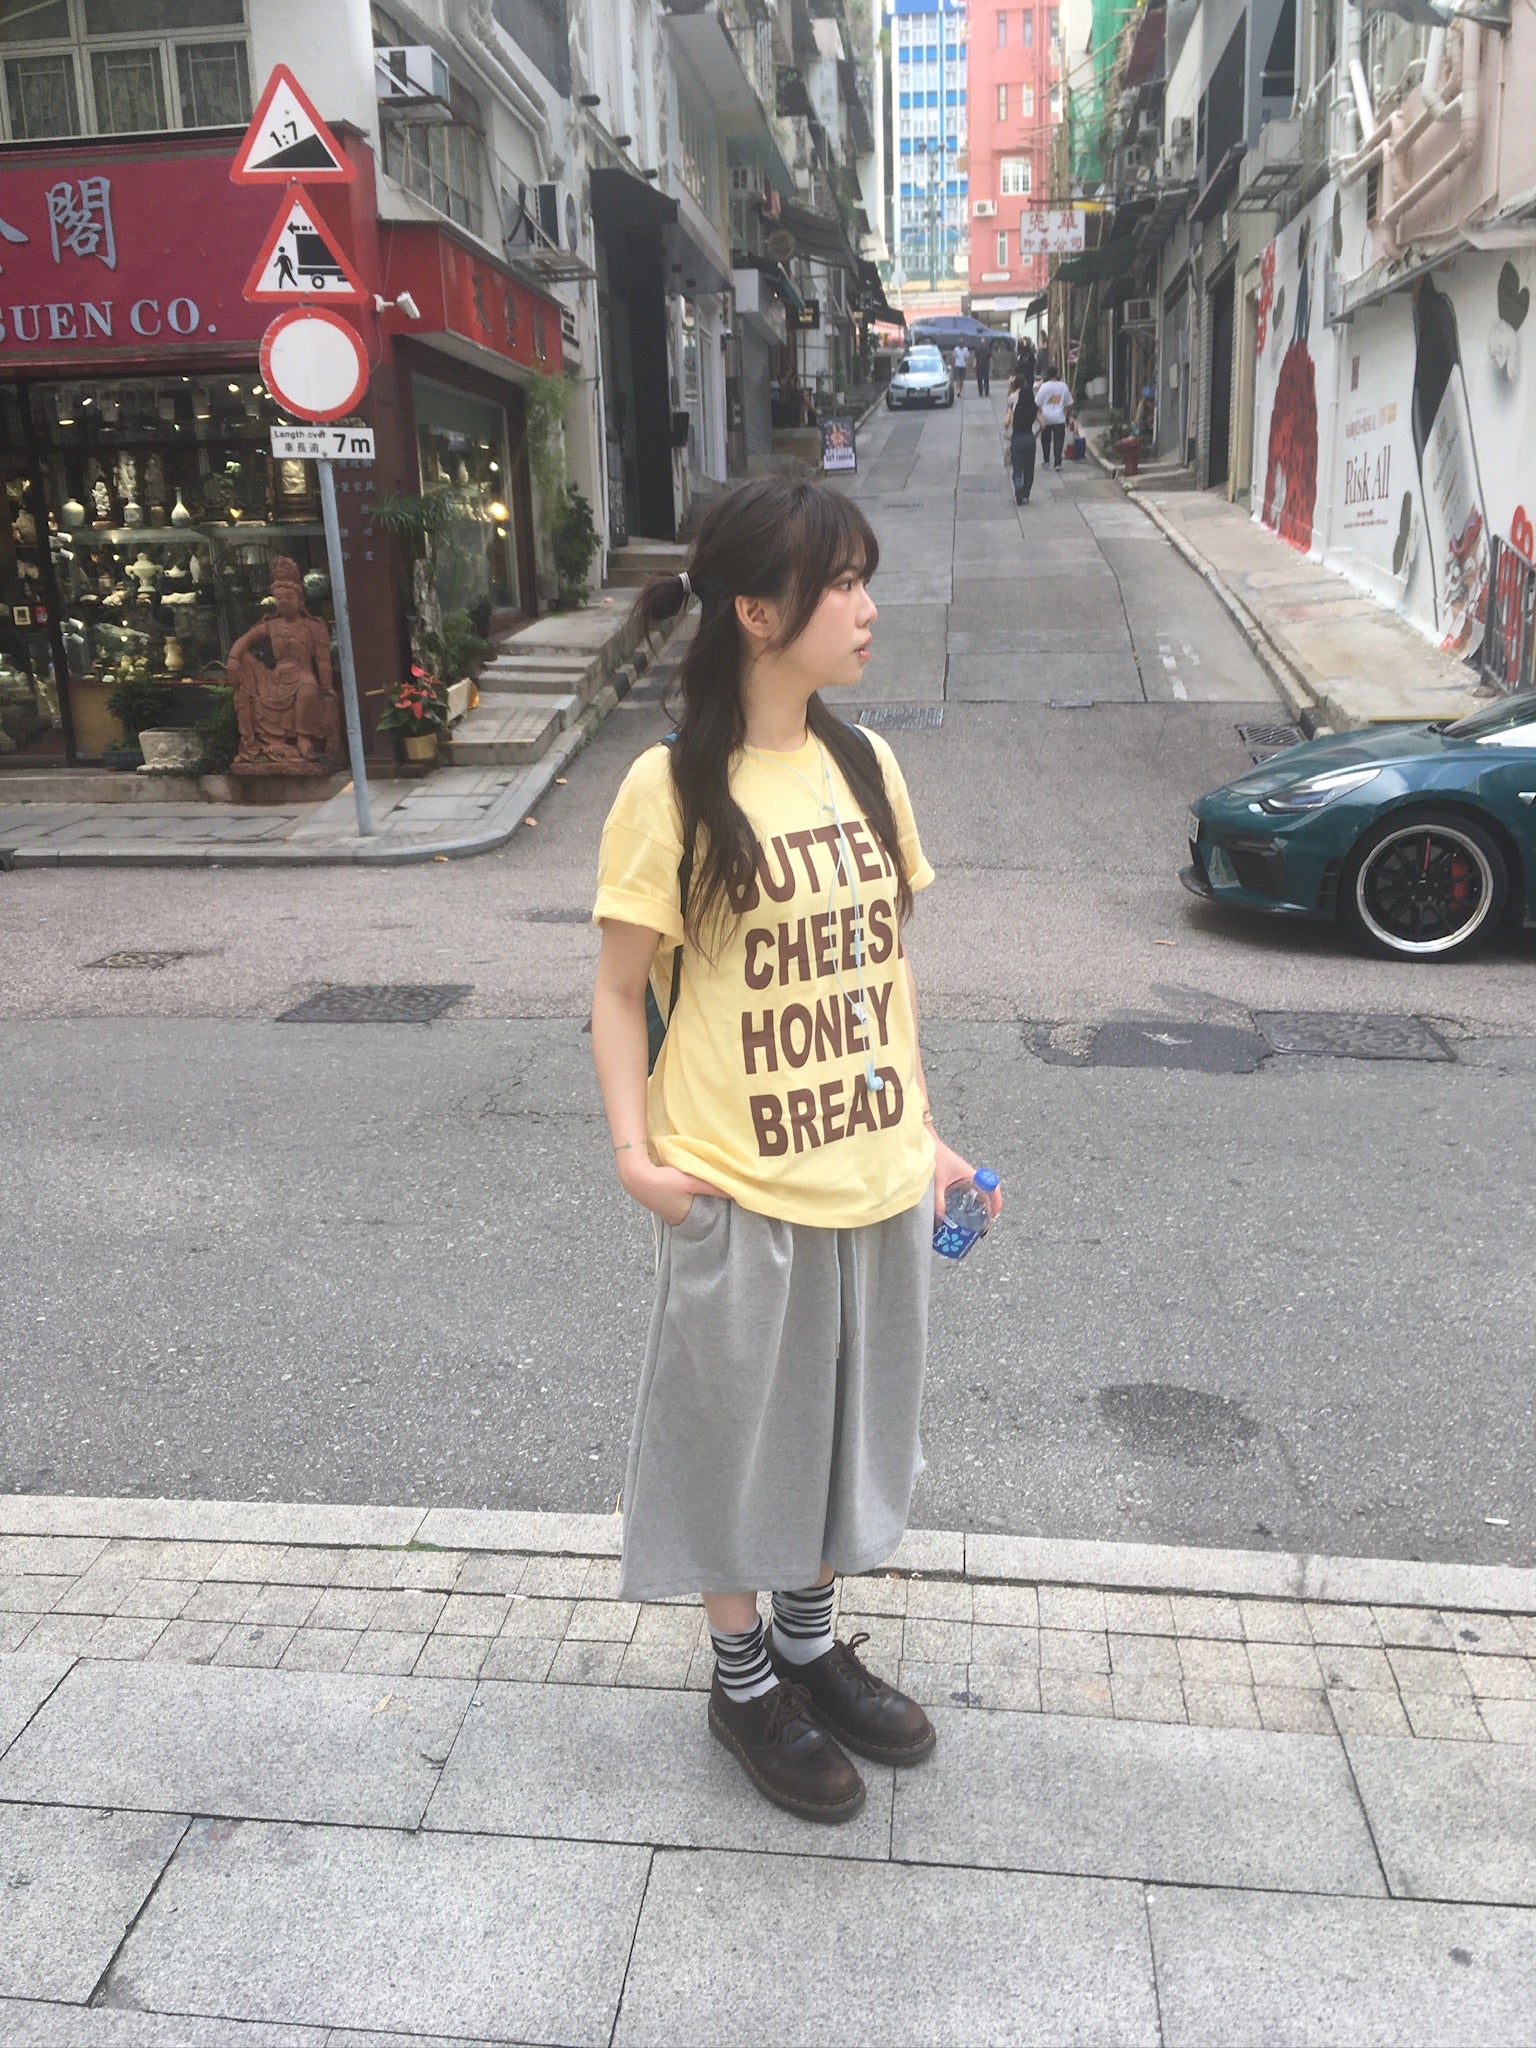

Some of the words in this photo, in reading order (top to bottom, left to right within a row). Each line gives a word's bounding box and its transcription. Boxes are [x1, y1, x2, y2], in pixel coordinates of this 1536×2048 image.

[270, 120, 298, 148] 1:7
[0, 176, 117, 270] 閣
[130, 297, 217, 337] CO.
[274, 430, 305, 440] Length
[1344, 452, 1371, 505] Risk
[1371, 444, 1391, 500] All
[741, 981, 893, 1075] HONEY
[749, 1066, 904, 1157] BREAD
